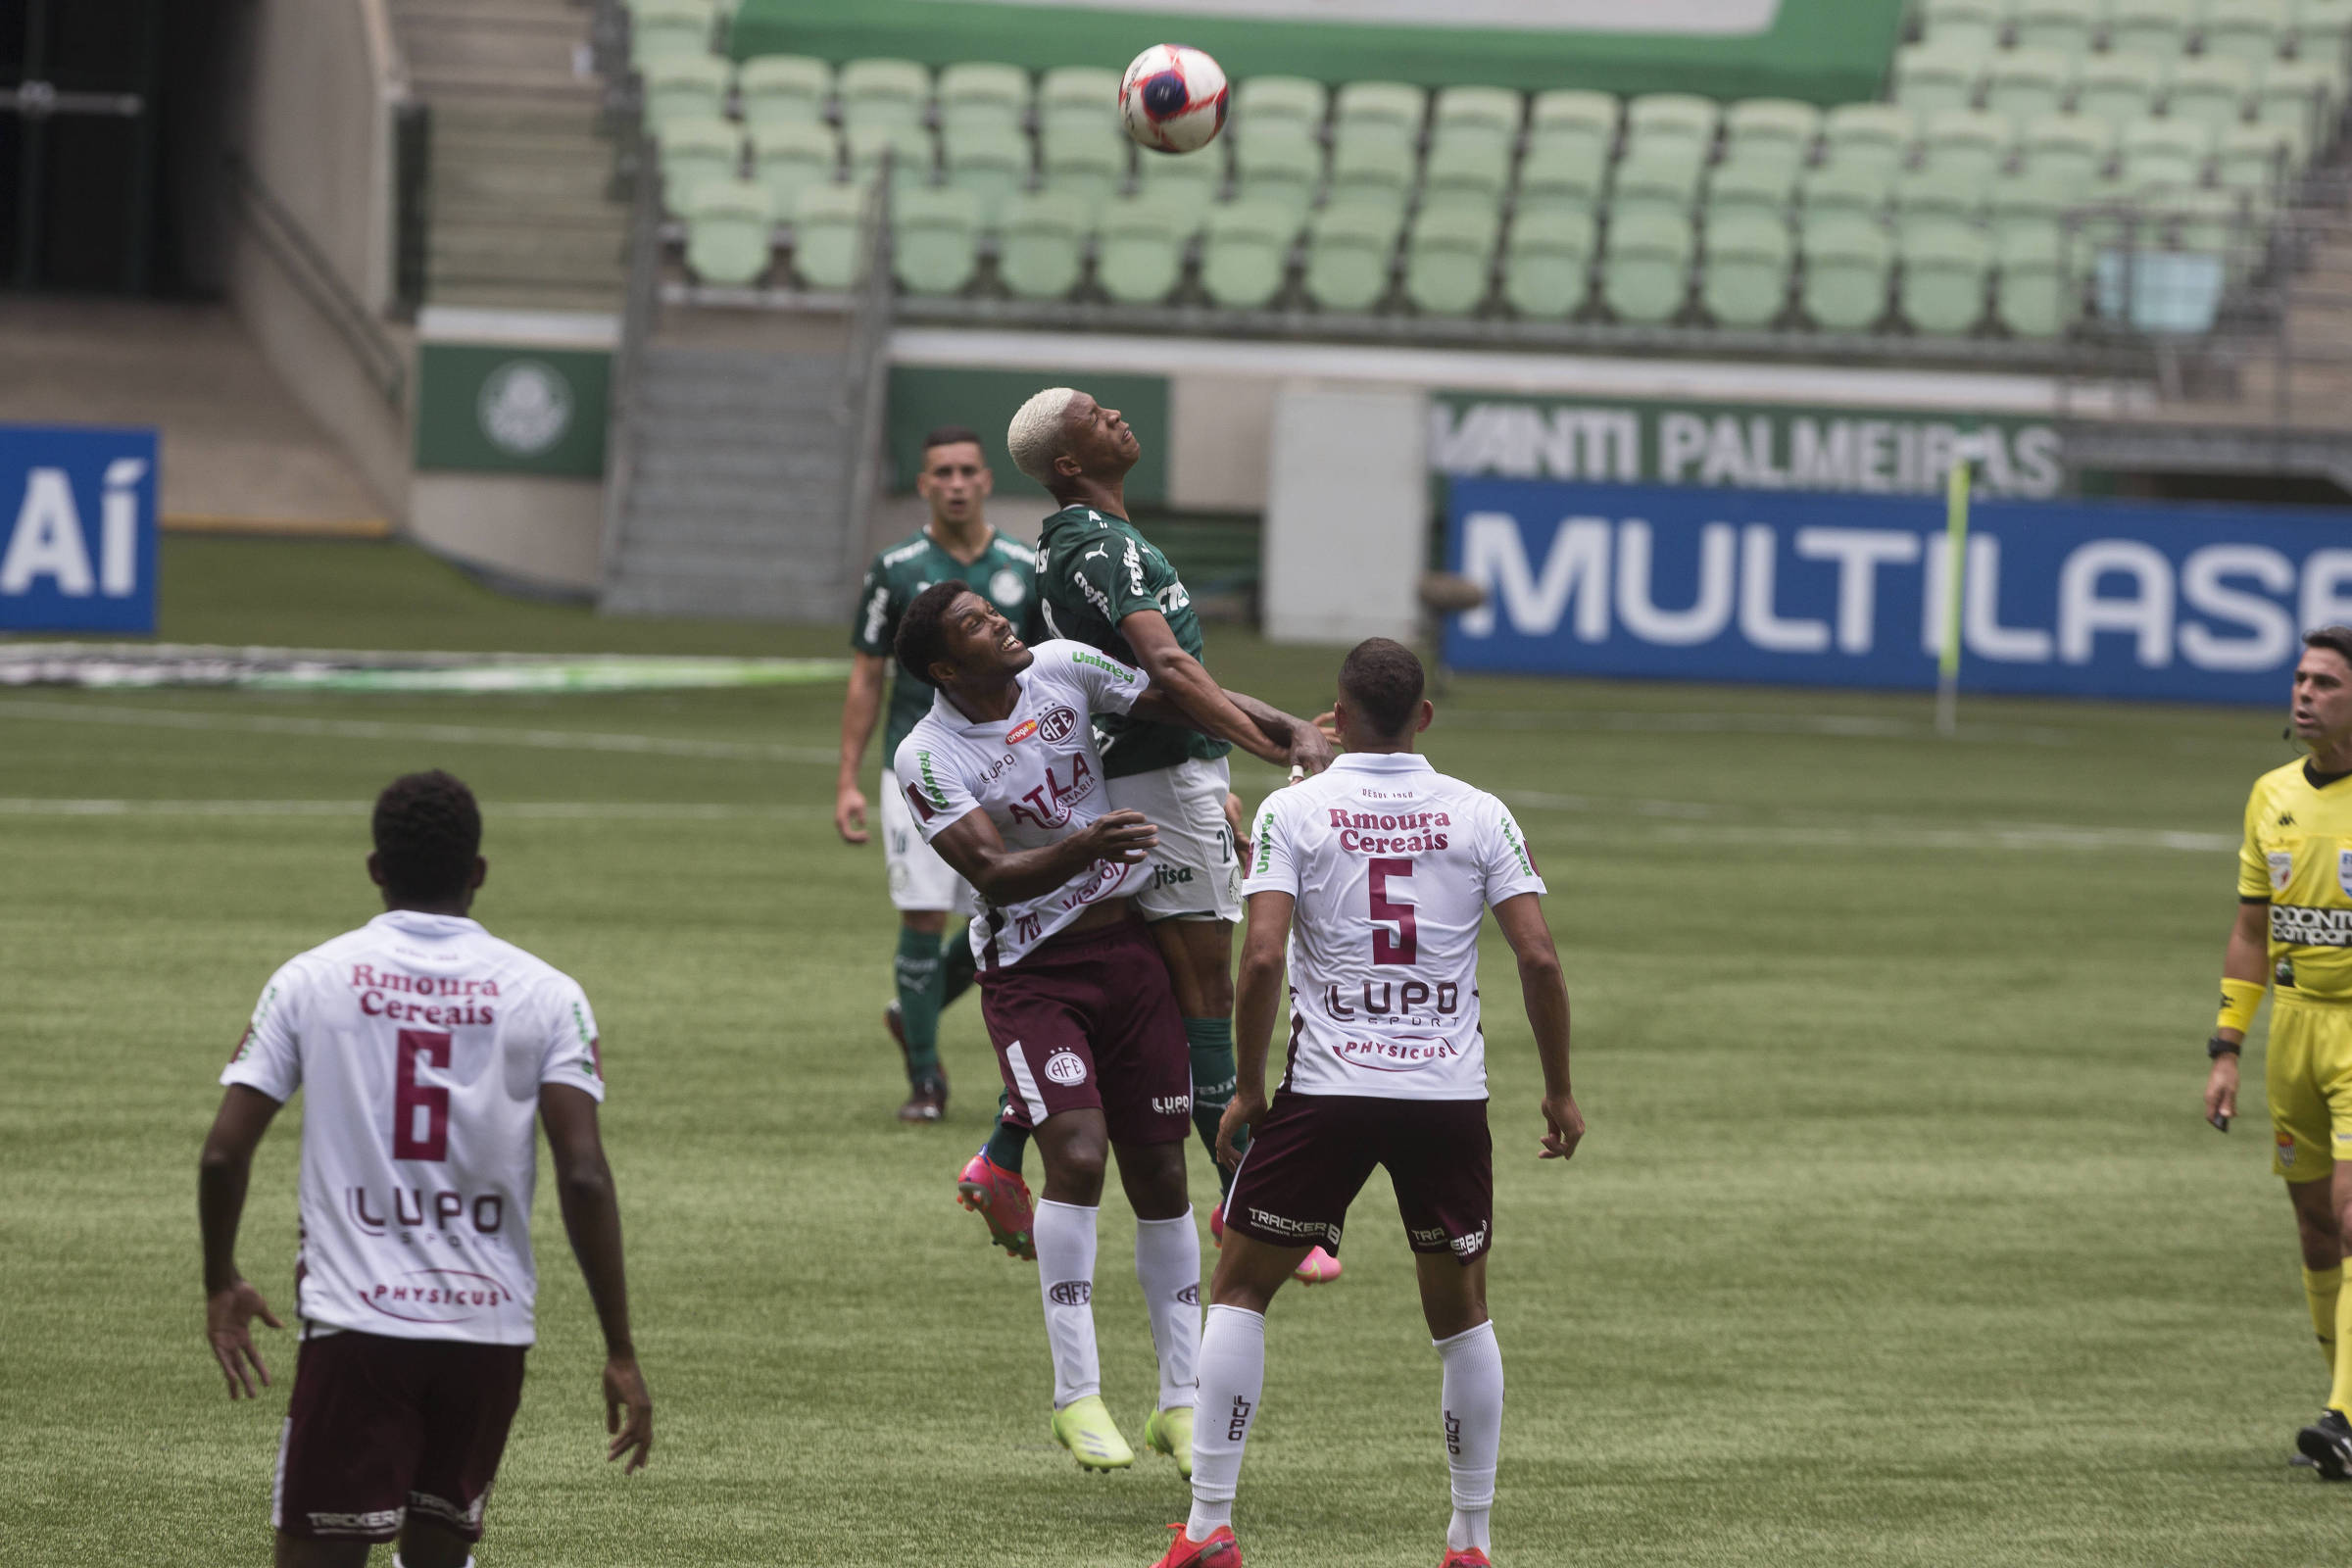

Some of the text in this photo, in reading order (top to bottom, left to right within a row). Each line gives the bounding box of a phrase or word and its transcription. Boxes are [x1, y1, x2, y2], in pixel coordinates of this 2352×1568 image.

[1658, 410, 2062, 500] PALMEIRAS
[1072, 651, 1135, 684] Unimed
[1042, 710, 1073, 740] AFE
[980, 754, 1015, 784] LUPO
[1328, 808, 1451, 831] Rmoura
[1255, 812, 1276, 874] Unimed
[1340, 829, 1449, 854] Cereais
[1368, 858, 1418, 965] 5
[351, 963, 500, 998] Rmoura
[360, 990, 494, 1025] Cereais
[1324, 981, 1458, 1022] LUPO
[1052, 1057, 1082, 1077] AFE
[1345, 1041, 1446, 1059] PHYSICUS
[394, 1028, 452, 1162] 6
[1152, 1095, 1189, 1113] LUPO
[346, 1187, 502, 1236] LUPO
[373, 1284, 500, 1307] PHYSICUS
[1228, 1396, 1251, 1441] LUPO
[1444, 1410, 1460, 1454] LUPO
